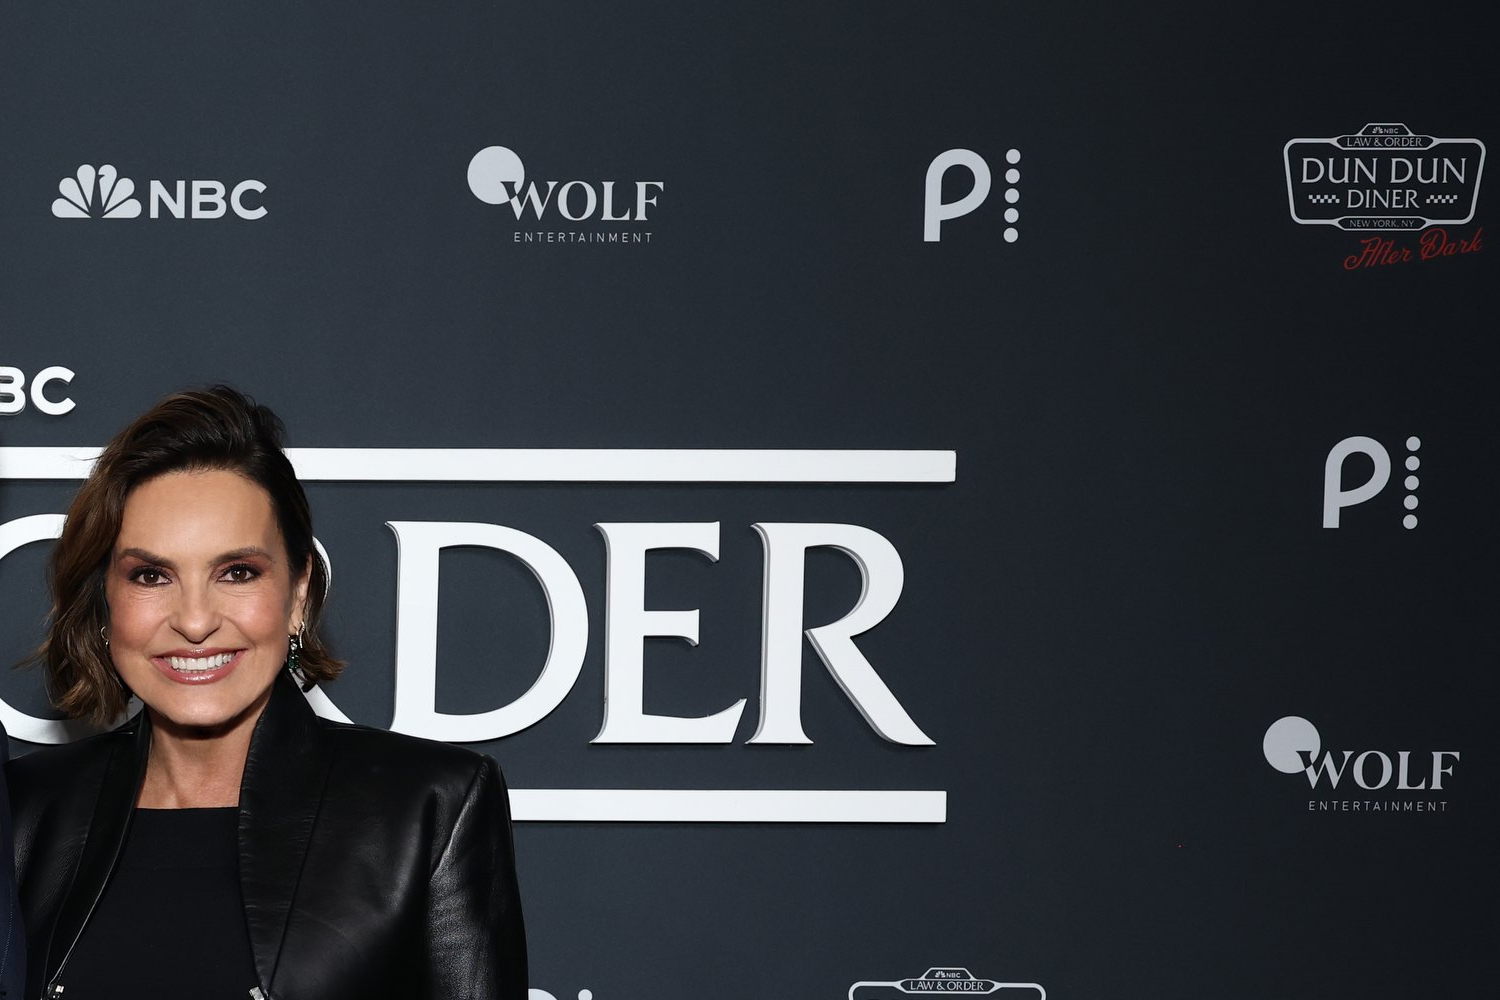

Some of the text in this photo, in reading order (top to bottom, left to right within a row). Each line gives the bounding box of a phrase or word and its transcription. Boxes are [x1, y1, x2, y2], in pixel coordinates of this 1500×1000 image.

[1347, 138, 1422, 147] LAW & ORDER
[1302, 158, 1466, 184] DUN DUN
[150, 180, 267, 219] NBC
[500, 181, 663, 220] WOLF
[1347, 189, 1421, 209] DINER
[515, 232, 651, 242] ENTERTAINMENT
[1344, 227, 1483, 270] After Dark
[1296, 751, 1459, 789] WOLF
[1309, 801, 1446, 811] ENTERTAINMENT
[910, 981, 984, 991] LAW & ORDER
